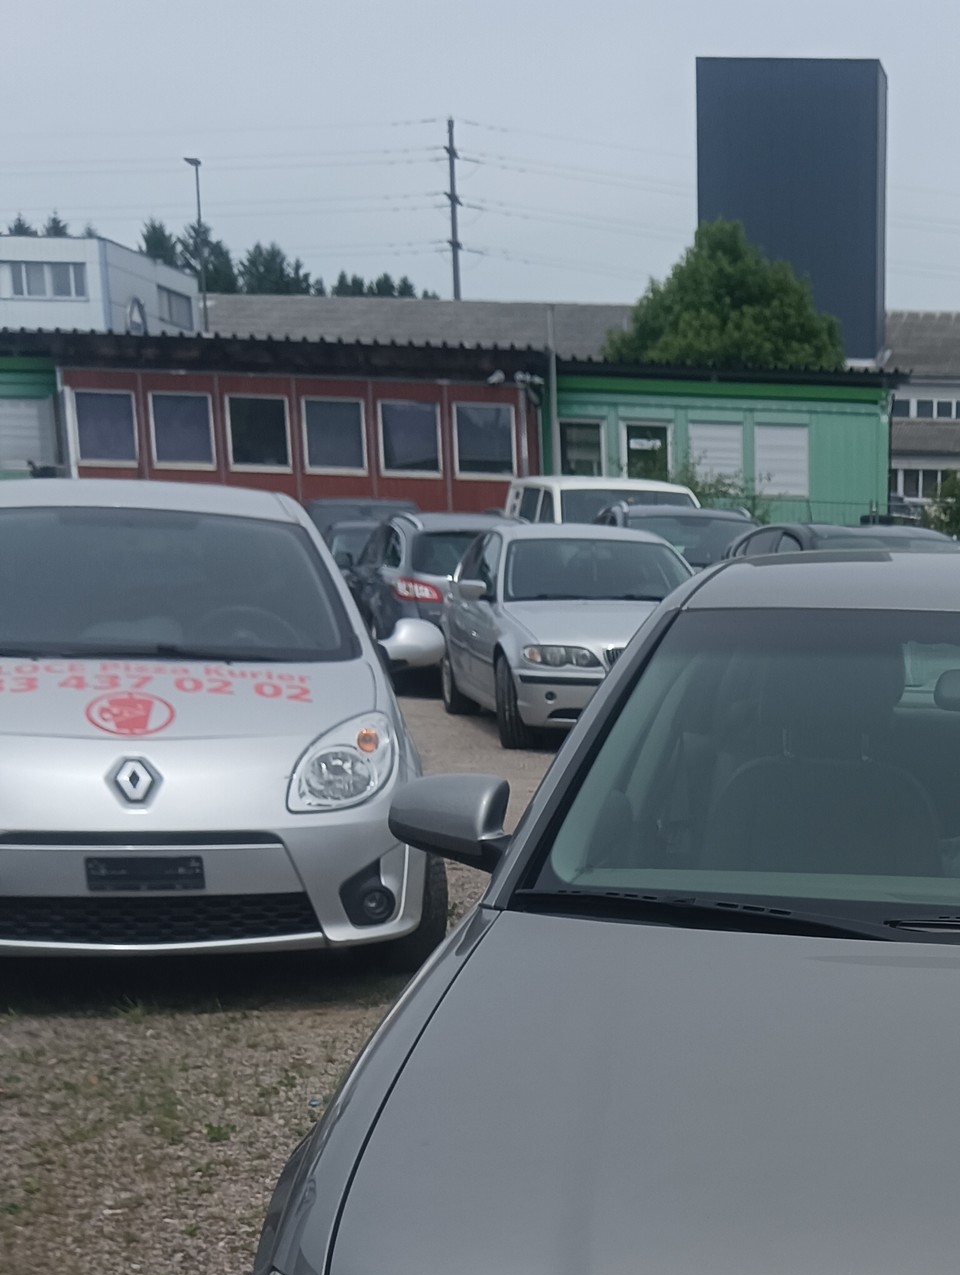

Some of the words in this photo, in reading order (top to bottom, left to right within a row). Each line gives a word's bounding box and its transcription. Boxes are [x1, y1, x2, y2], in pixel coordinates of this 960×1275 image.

[100, 662, 190, 675] Pizza
[203, 665, 311, 684] Kurier
[0, 675, 39, 693] 3
[57, 673, 153, 690] 437
[174, 676, 235, 696] 02
[253, 681, 313, 703] 02
